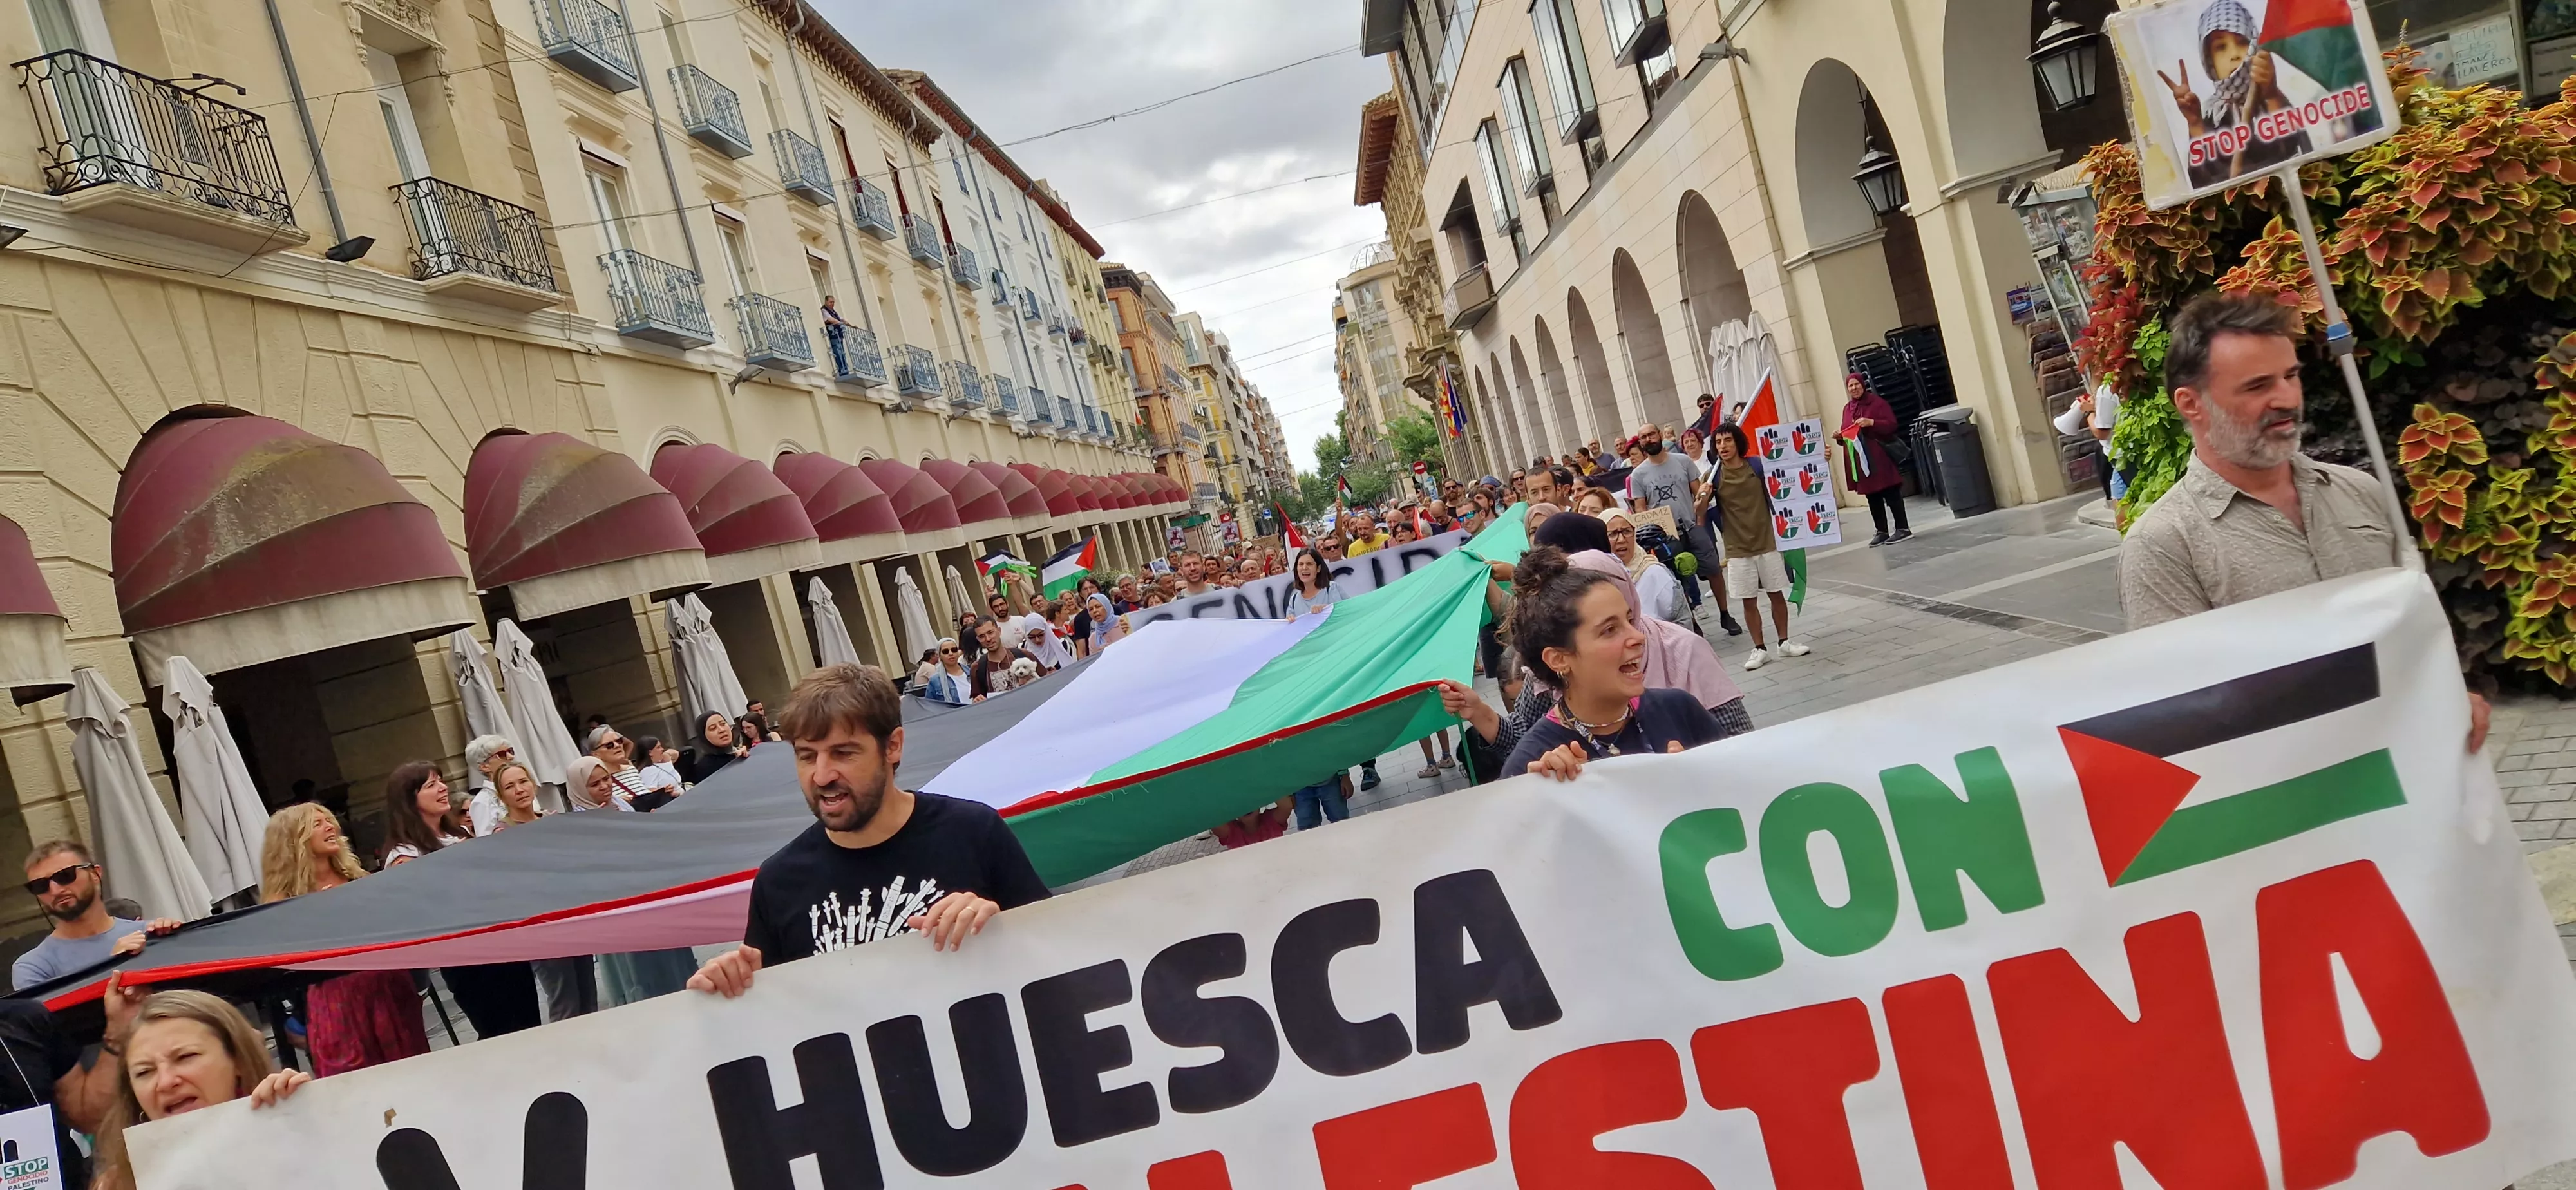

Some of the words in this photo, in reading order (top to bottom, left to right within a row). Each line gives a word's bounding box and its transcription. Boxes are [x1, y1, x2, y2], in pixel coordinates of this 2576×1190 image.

[2190, 126, 2250, 164] STOP
[2257, 86, 2371, 140] GENOCIDE
[1634, 511, 1658, 522] CADA
[706, 869, 1563, 1190] HUESCA
[1659, 746, 2046, 982] CON
[5, 1157, 48, 1179] STOP
[8, 1170, 48, 1184] GENOCIDIO
[8, 1177, 49, 1190] PALESTINO
